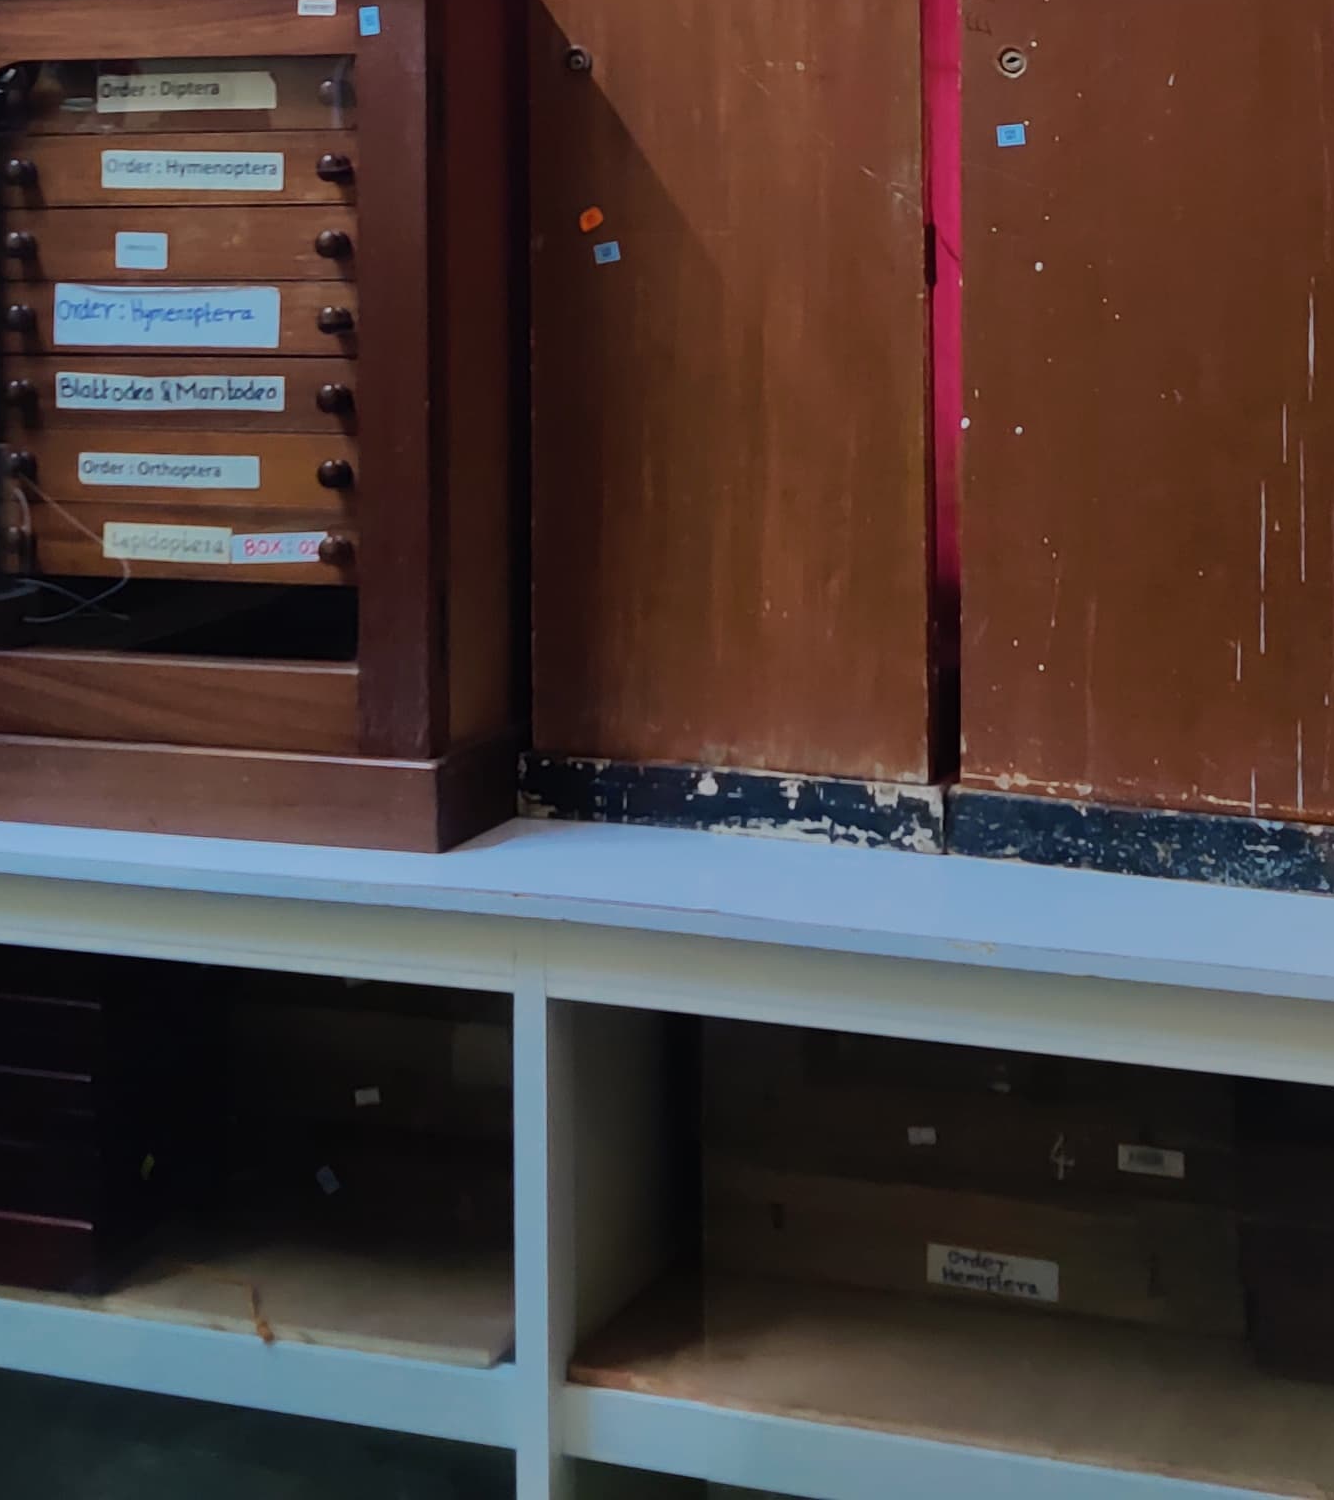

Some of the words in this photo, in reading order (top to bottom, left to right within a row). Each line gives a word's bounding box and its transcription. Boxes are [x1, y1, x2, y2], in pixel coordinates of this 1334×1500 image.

[100, 82, 146, 100] Order
[160, 80, 220, 100] Diptera
[105, 157, 153, 175] Order
[165, 158, 278, 179] Hymenoptera
[57, 299, 114, 322] Order
[130, 300, 255, 332] Hymenoptera
[81, 460, 125, 476] Order
[137, 460, 222, 481] Orthoptera
[243, 537, 283, 557] BOX
[1048, 1131, 1076, 1181] 4
